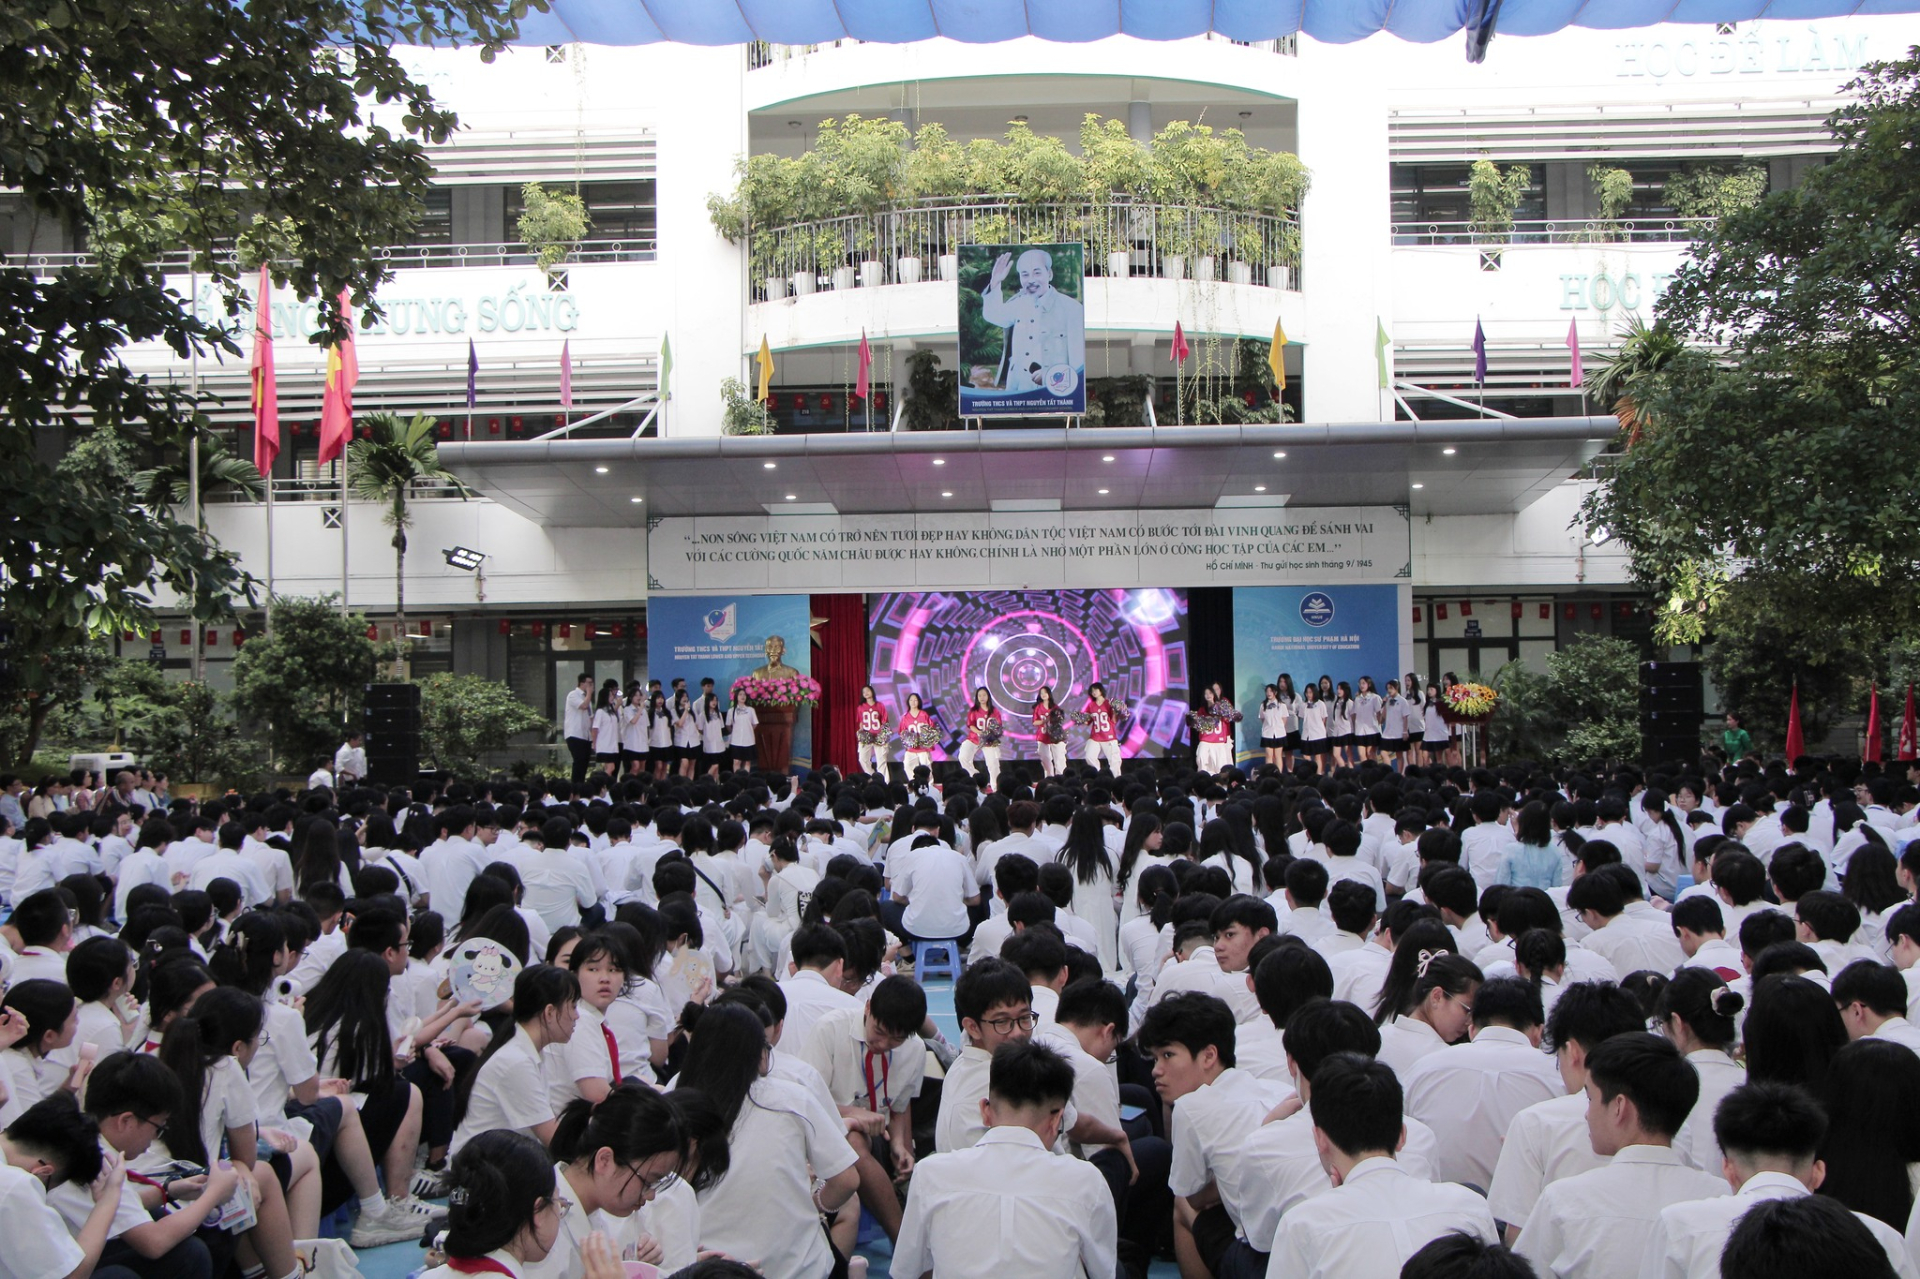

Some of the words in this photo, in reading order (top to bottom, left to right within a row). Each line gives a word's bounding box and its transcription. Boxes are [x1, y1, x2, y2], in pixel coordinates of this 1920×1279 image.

[1615, 40, 1698, 86] HỌC
[1776, 24, 1869, 72] LÀM
[478, 279, 581, 335] SỐNG
[1559, 272, 1642, 322] HỌC
[727, 531, 756, 544] SÔNG
[760, 530, 787, 545] VIỆT
[790, 532, 817, 543] NAM
[820, 529, 836, 542] CÓ
[838, 529, 862, 542] TRỞ
[864, 529, 888, 542] NÊN
[891, 530, 918, 541] TƯƠI
[921, 530, 944, 543] ĐẸP
[945, 530, 969, 540] HAY
[1015, 527, 1039, 540] DÂN
[1041, 526, 1066, 540] TỘC
[1069, 525, 1096, 540] VIỆT
[1100, 527, 1126, 538] NAM
[1128, 524, 1145, 537] CÓ
[1148, 524, 1178, 537] BƯỚC
[1182, 524, 1202, 536] TỚI
[1204, 524, 1224, 536] ĐÀI
[1228, 526, 1259, 536] VINH
[1260, 525, 1299, 538] QUANG
[1302, 520, 1318, 535] ĐỂ
[1320, 522, 1351, 534] SÁNH
[1354, 523, 1374, 534] VAI
[685, 549, 706, 562] VỚI
[709, 549, 733, 562] CÁC
[735, 548, 775, 561] CƯỜNG
[778, 546, 810, 563] QUỐC
[812, 548, 839, 560] NĂM
[840, 548, 872, 560] CHÂU
[875, 548, 906, 561] ĐƯỢC
[909, 549, 933, 559] HAY
[980, 544, 1019, 558] CHÍNH
[1022, 544, 1038, 557] LÀ
[1041, 544, 1066, 557] NHỜ
[1069, 544, 1094, 558] MỘT
[1098, 542, 1130, 556] PHẦN
[1134, 542, 1158, 556] LỚN
[1160, 542, 1168, 555] Ở
[1171, 541, 1202, 555] CÔNG
[1206, 544, 1229, 556] HỌC
[1232, 542, 1254, 556] TẬP
[1257, 540, 1280, 553] CỦA
[1282, 540, 1304, 553] CÁC
[1220, 560, 1233, 570] CHÍ
[1275, 560, 1288, 571] gửi
[1289, 562, 1303, 570] học
[1322, 560, 1344, 569] tháng
[1356, 559, 1373, 567] 1945
